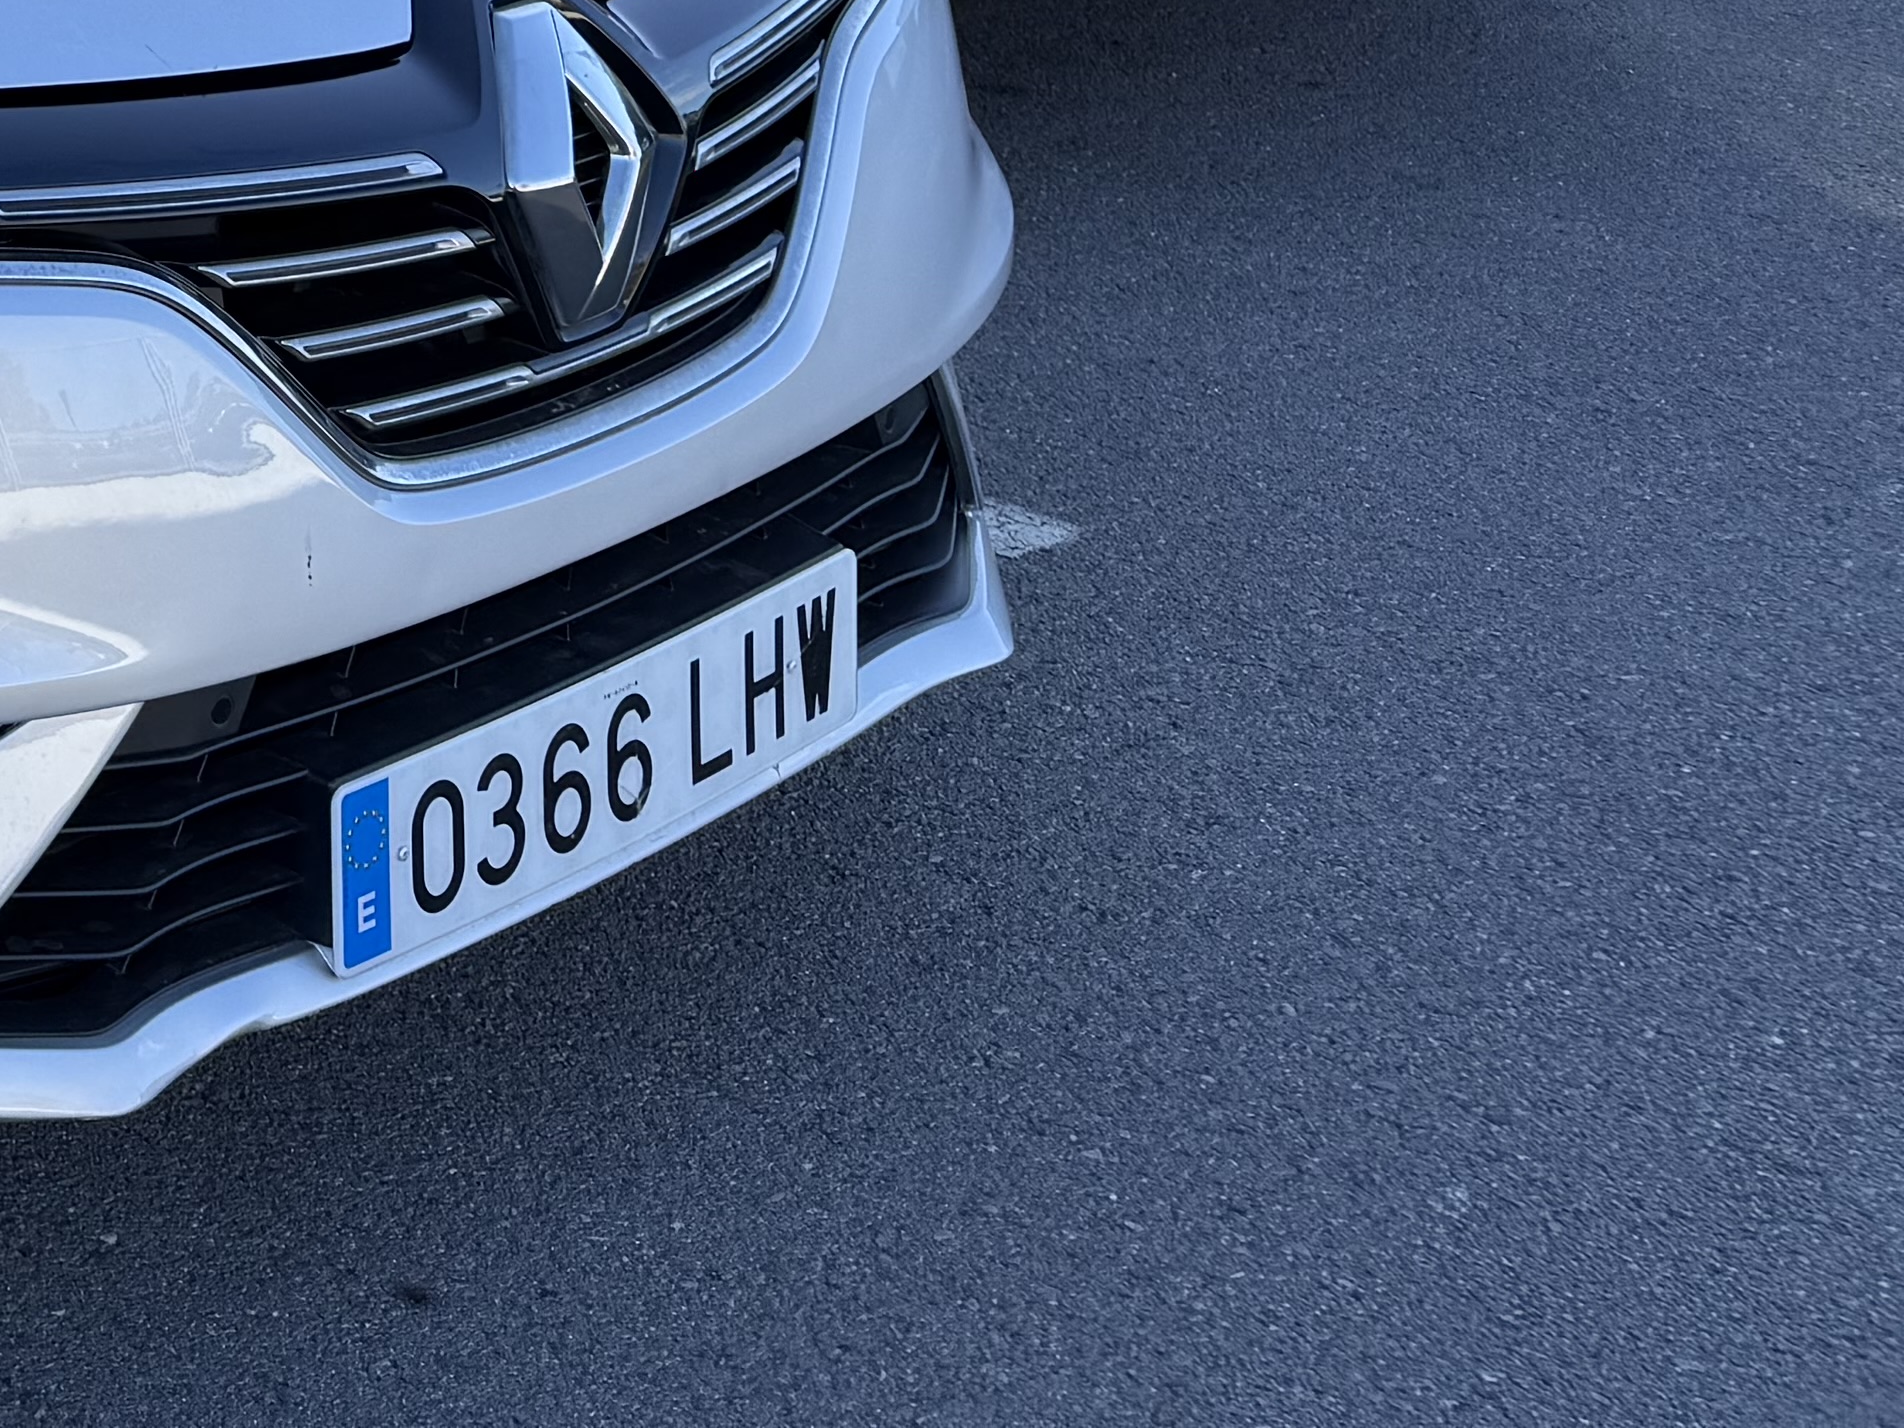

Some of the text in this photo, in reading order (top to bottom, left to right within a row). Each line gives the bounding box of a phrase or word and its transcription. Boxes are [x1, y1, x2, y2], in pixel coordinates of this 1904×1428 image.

[356, 586, 837, 935] E 0366 LHW
